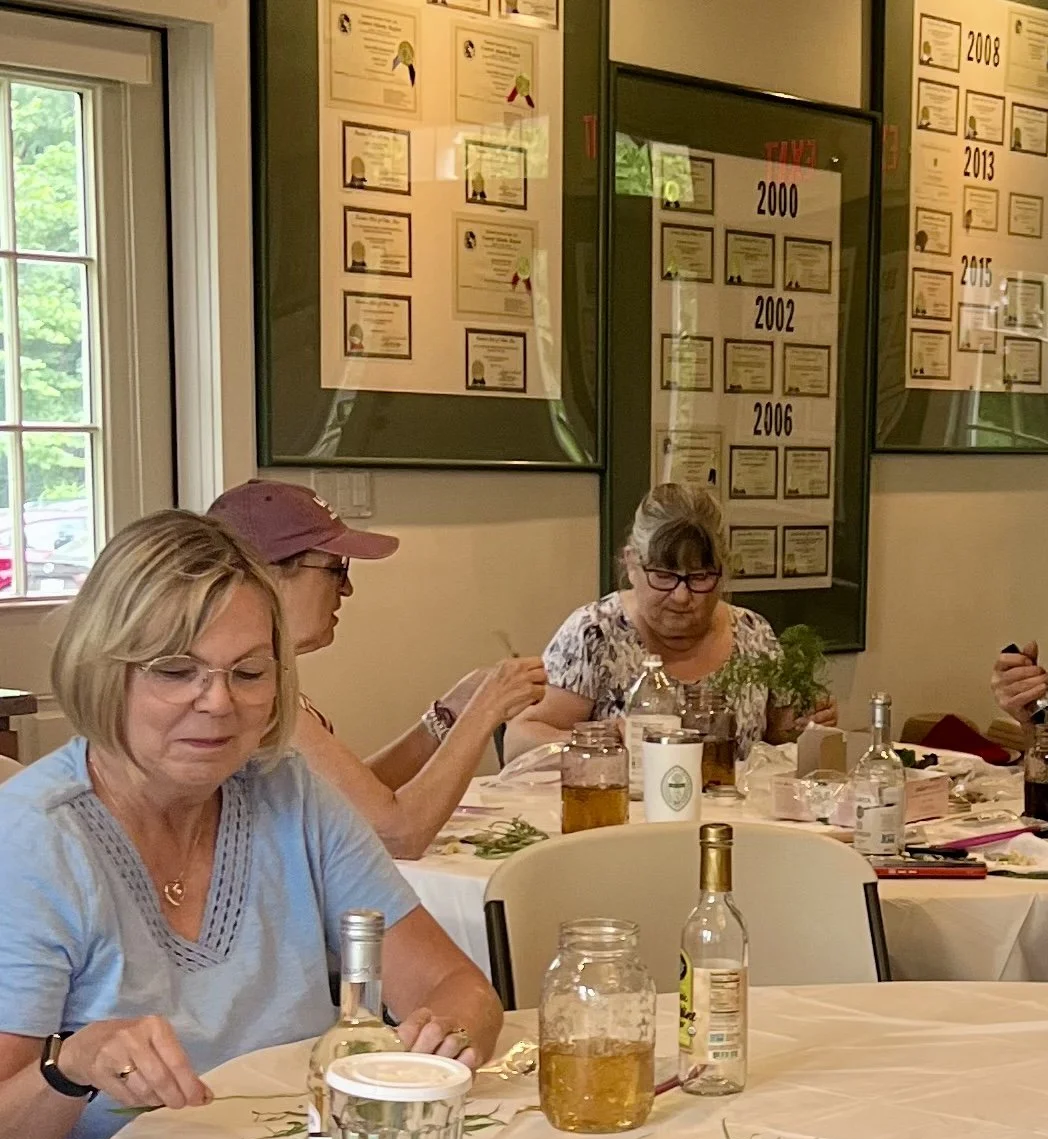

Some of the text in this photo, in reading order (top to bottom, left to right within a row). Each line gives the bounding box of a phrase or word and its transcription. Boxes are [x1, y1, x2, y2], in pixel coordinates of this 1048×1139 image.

[967, 30, 1001, 67] 2008
[963, 146, 995, 181] 2013
[757, 180, 799, 218] 2000
[960, 255, 993, 288] 2015
[755, 295, 795, 332] 2002
[753, 402, 793, 437] 2006
